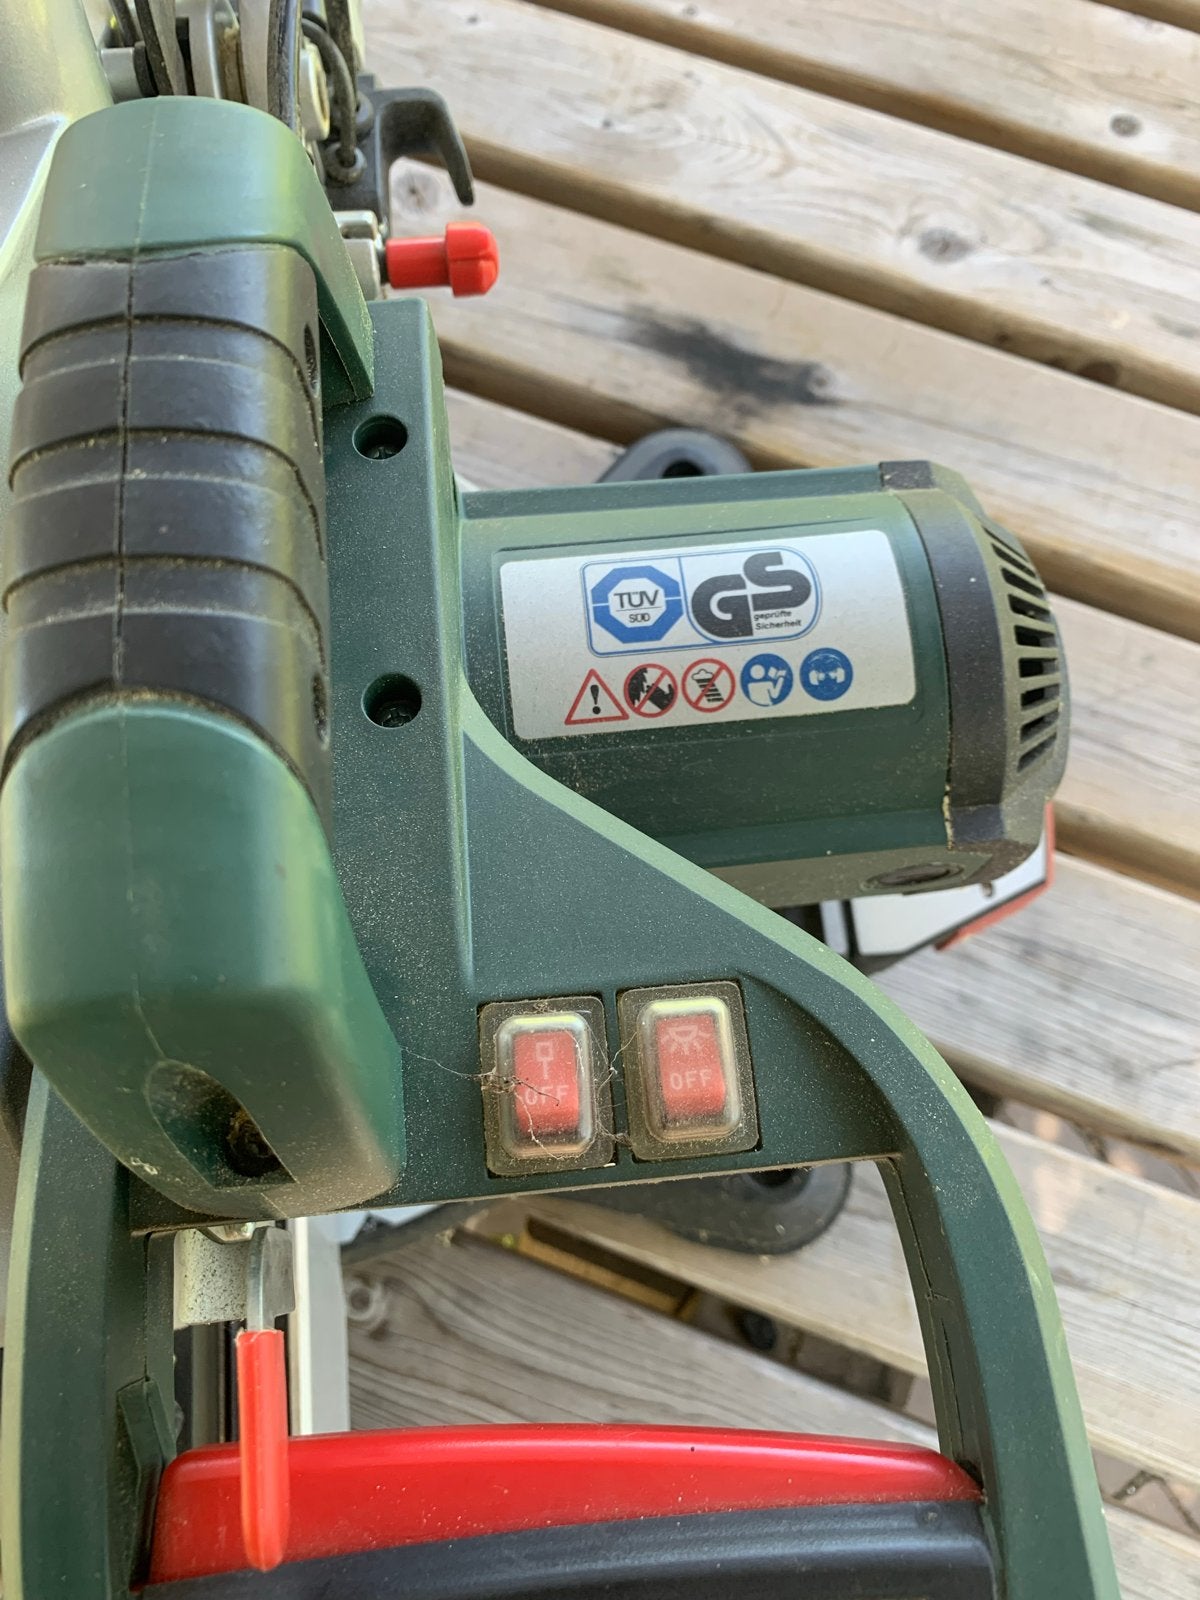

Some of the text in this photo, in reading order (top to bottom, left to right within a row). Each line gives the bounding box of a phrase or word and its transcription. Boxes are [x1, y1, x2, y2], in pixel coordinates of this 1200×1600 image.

[613, 589, 660, 609] TÜV
[691, 551, 812, 639] GS
[753, 610, 792, 622] geprüfte
[755, 619, 802, 631] Sicherheit
[669, 1068, 713, 1091] OFF
[524, 1084, 570, 1106] OFF
